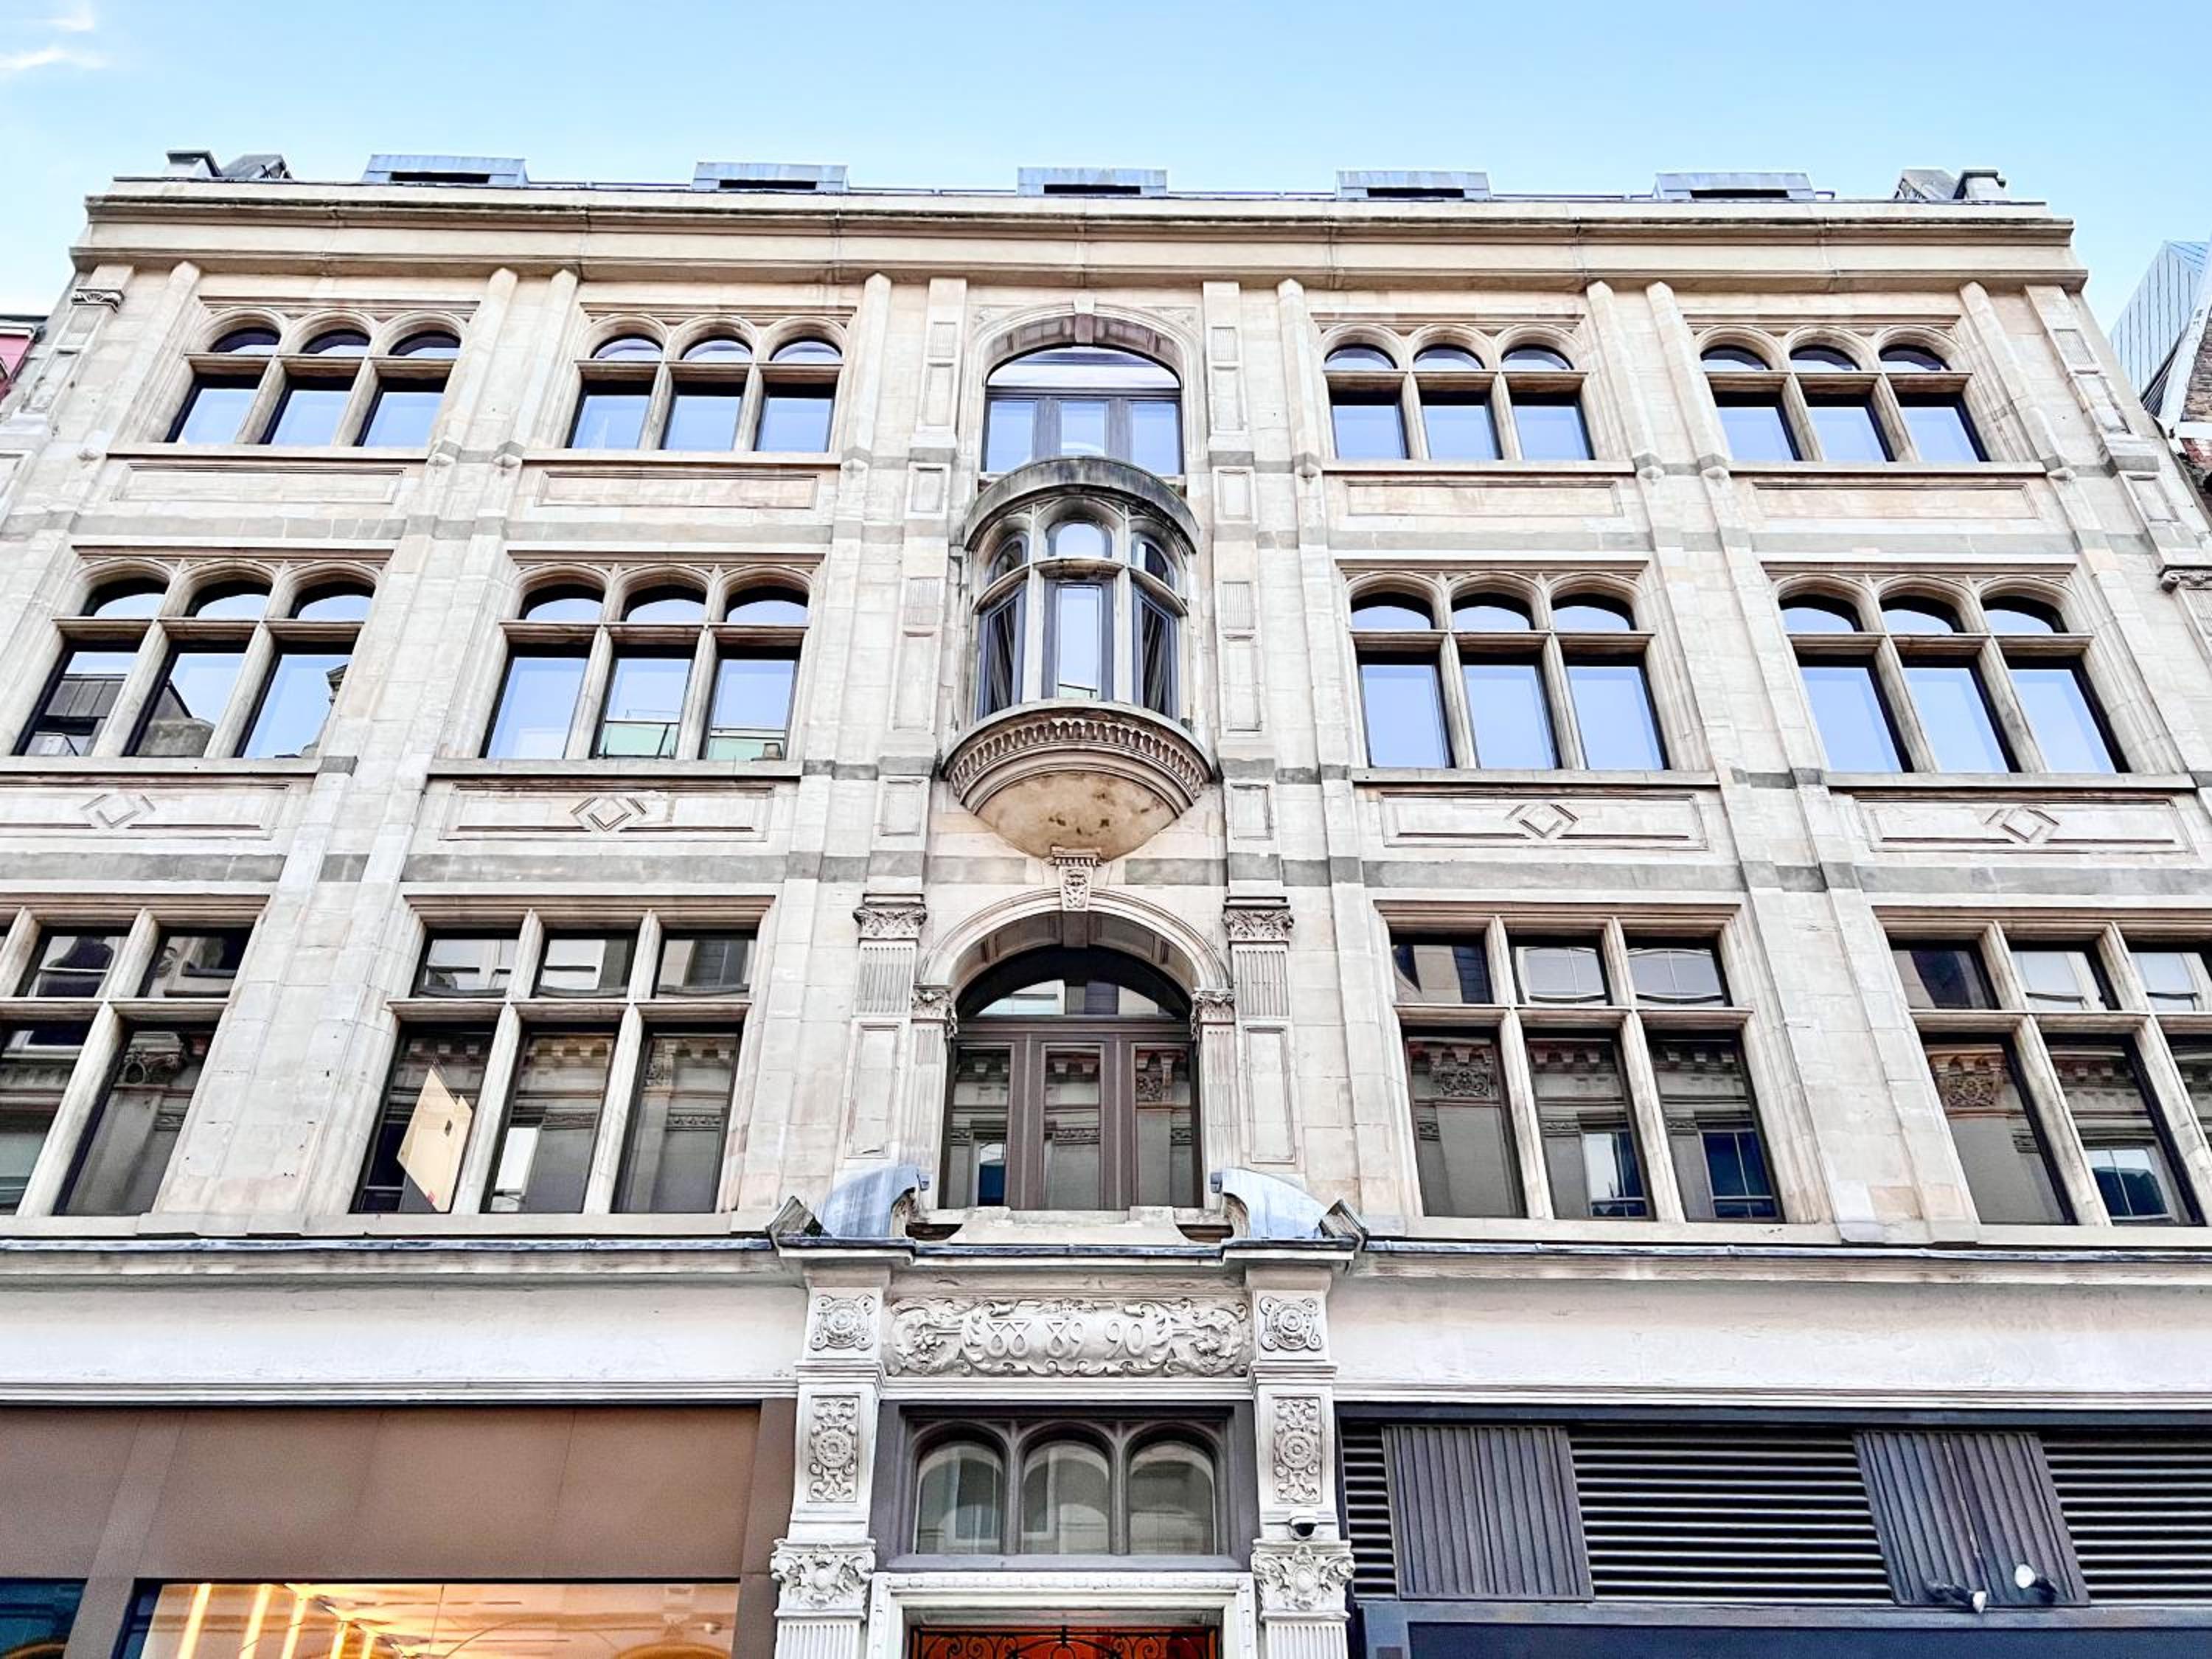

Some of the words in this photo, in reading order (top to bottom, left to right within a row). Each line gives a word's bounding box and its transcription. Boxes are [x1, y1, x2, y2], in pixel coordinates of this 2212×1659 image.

[986, 1318, 1032, 1358] 88
[1046, 1318, 1085, 1359] 89
[1105, 1321, 1144, 1360] 90
